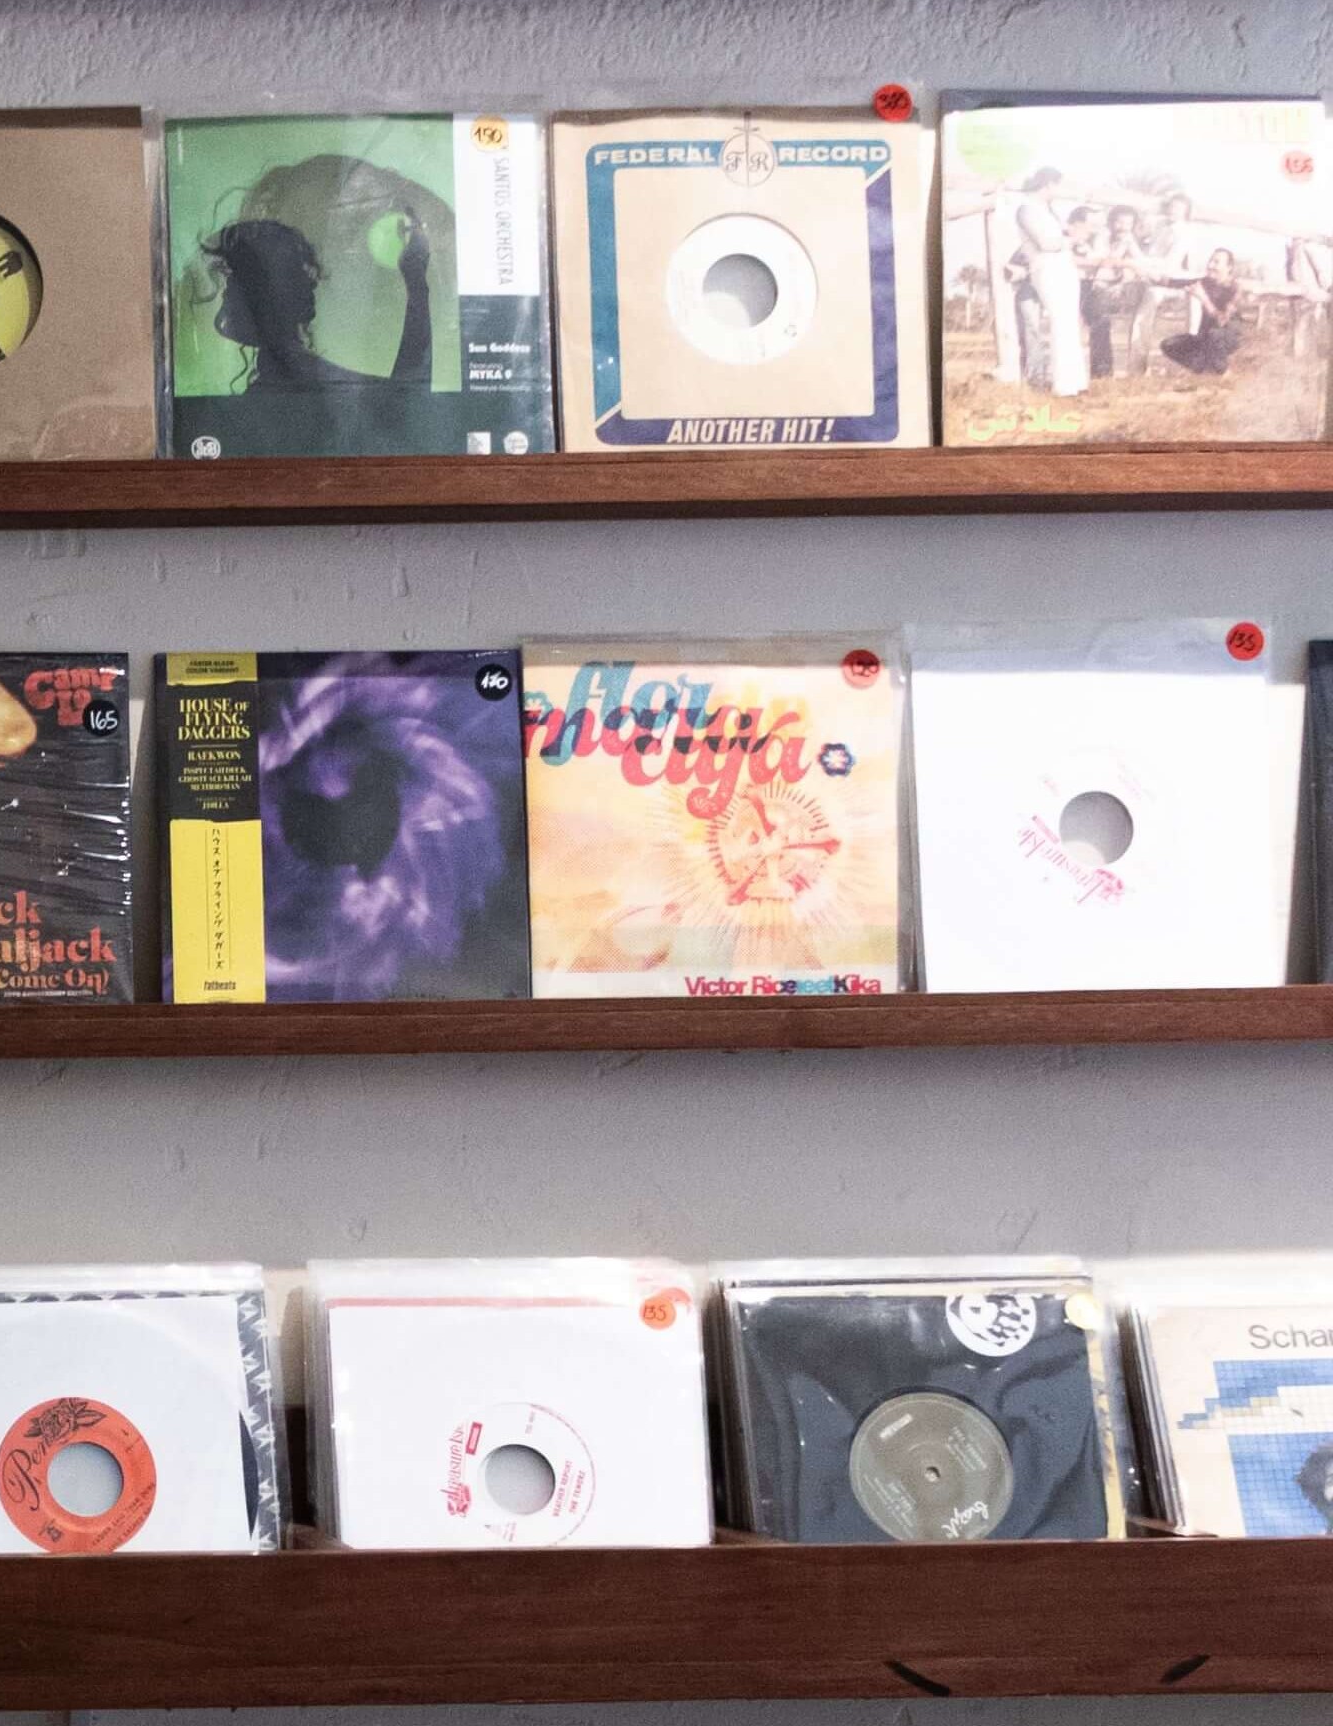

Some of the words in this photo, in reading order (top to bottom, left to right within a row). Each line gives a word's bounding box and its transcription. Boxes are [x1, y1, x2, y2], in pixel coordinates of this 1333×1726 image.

[594, 144, 715, 165] FEDERAL
[779, 145, 888, 162] RECORD
[493, 157, 511, 206] SANTOS
[495, 211, 514, 286] ORCHESTRA
[666, 418, 775, 444] ANOTHER
[781, 417, 836, 442] HIT!
[56, 689, 92, 727] Lo
[179, 698, 232, 713] HOUSE
[234, 700, 250, 712] OF
[541, 660, 717, 766] flor
[90, 709, 118, 730] 165
[184, 712, 244, 726] FLYING
[177, 725, 251, 741] DAGGERS
[684, 976, 747, 996] Victor
